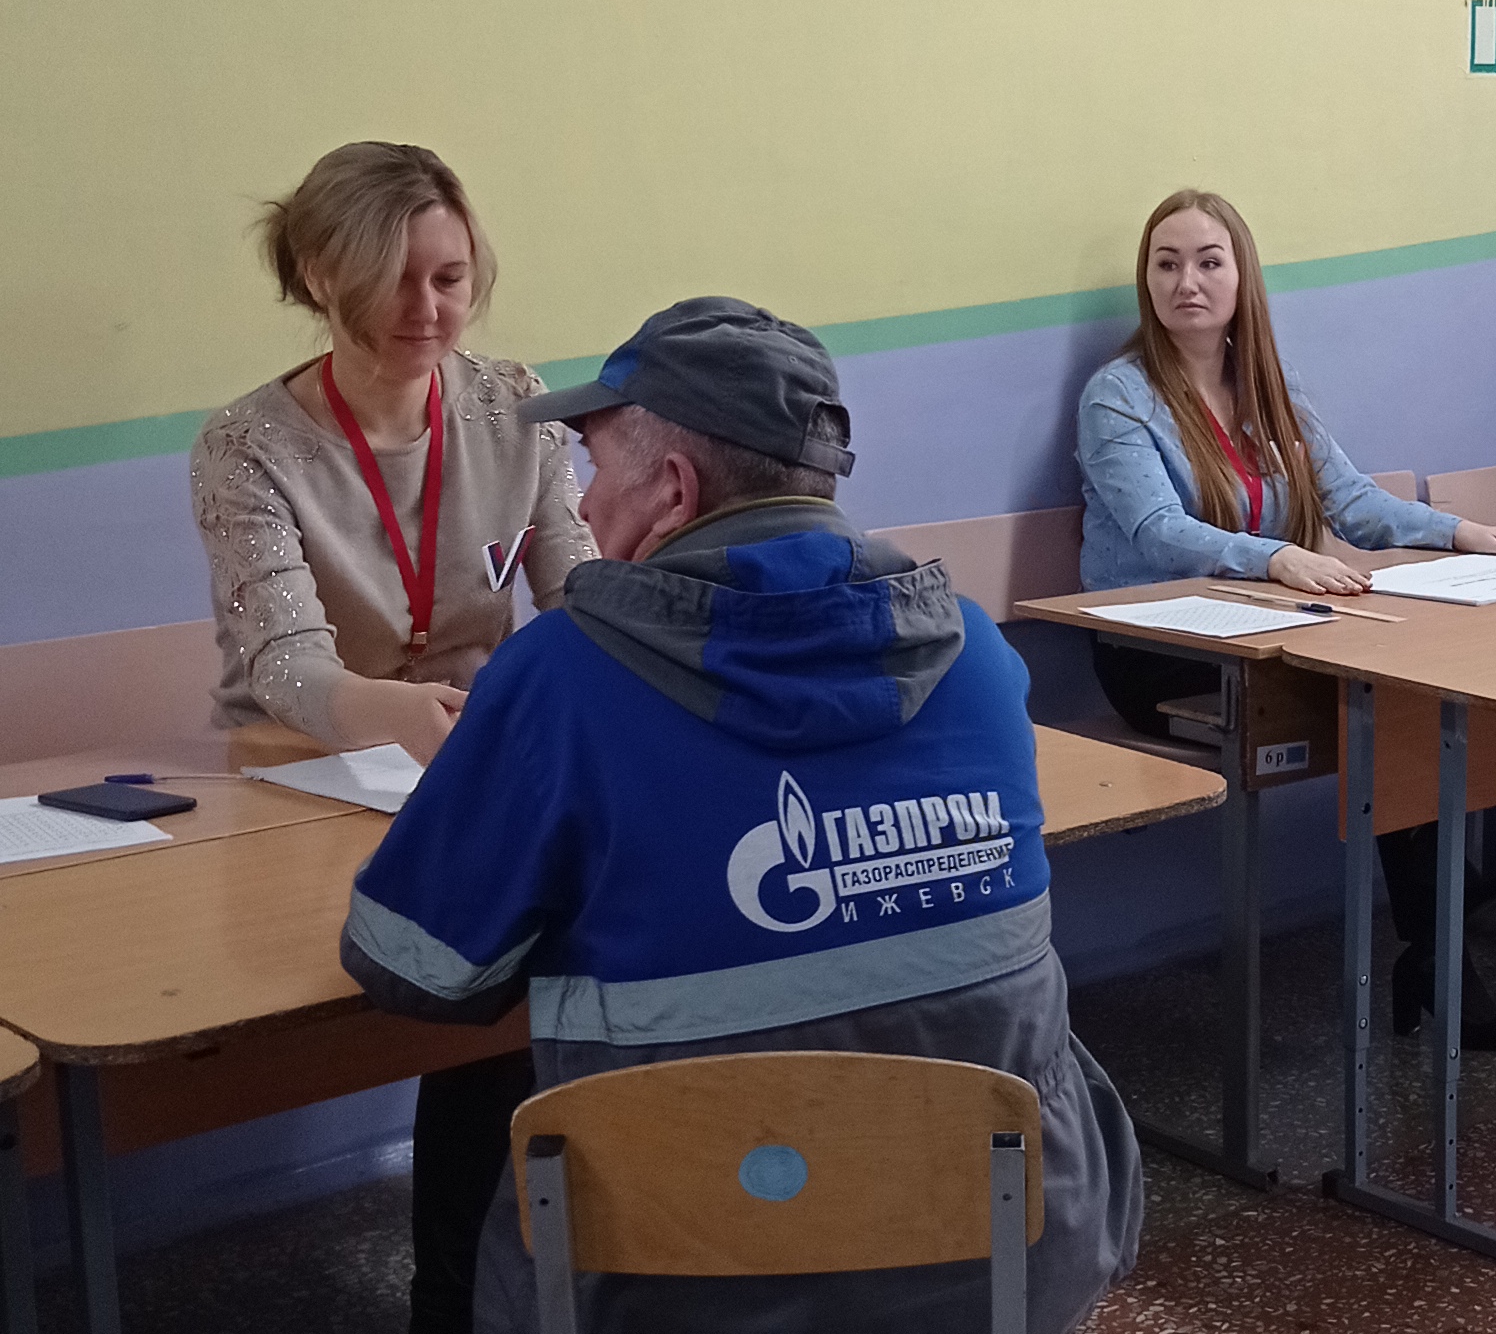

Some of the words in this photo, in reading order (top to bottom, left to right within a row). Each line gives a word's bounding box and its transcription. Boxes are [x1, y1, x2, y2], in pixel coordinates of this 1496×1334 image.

[1265, 749, 1273, 765] 6
[821, 791, 1011, 862] ГАЗПРОМ
[840, 867, 1016, 923] ИЖЕВСК
